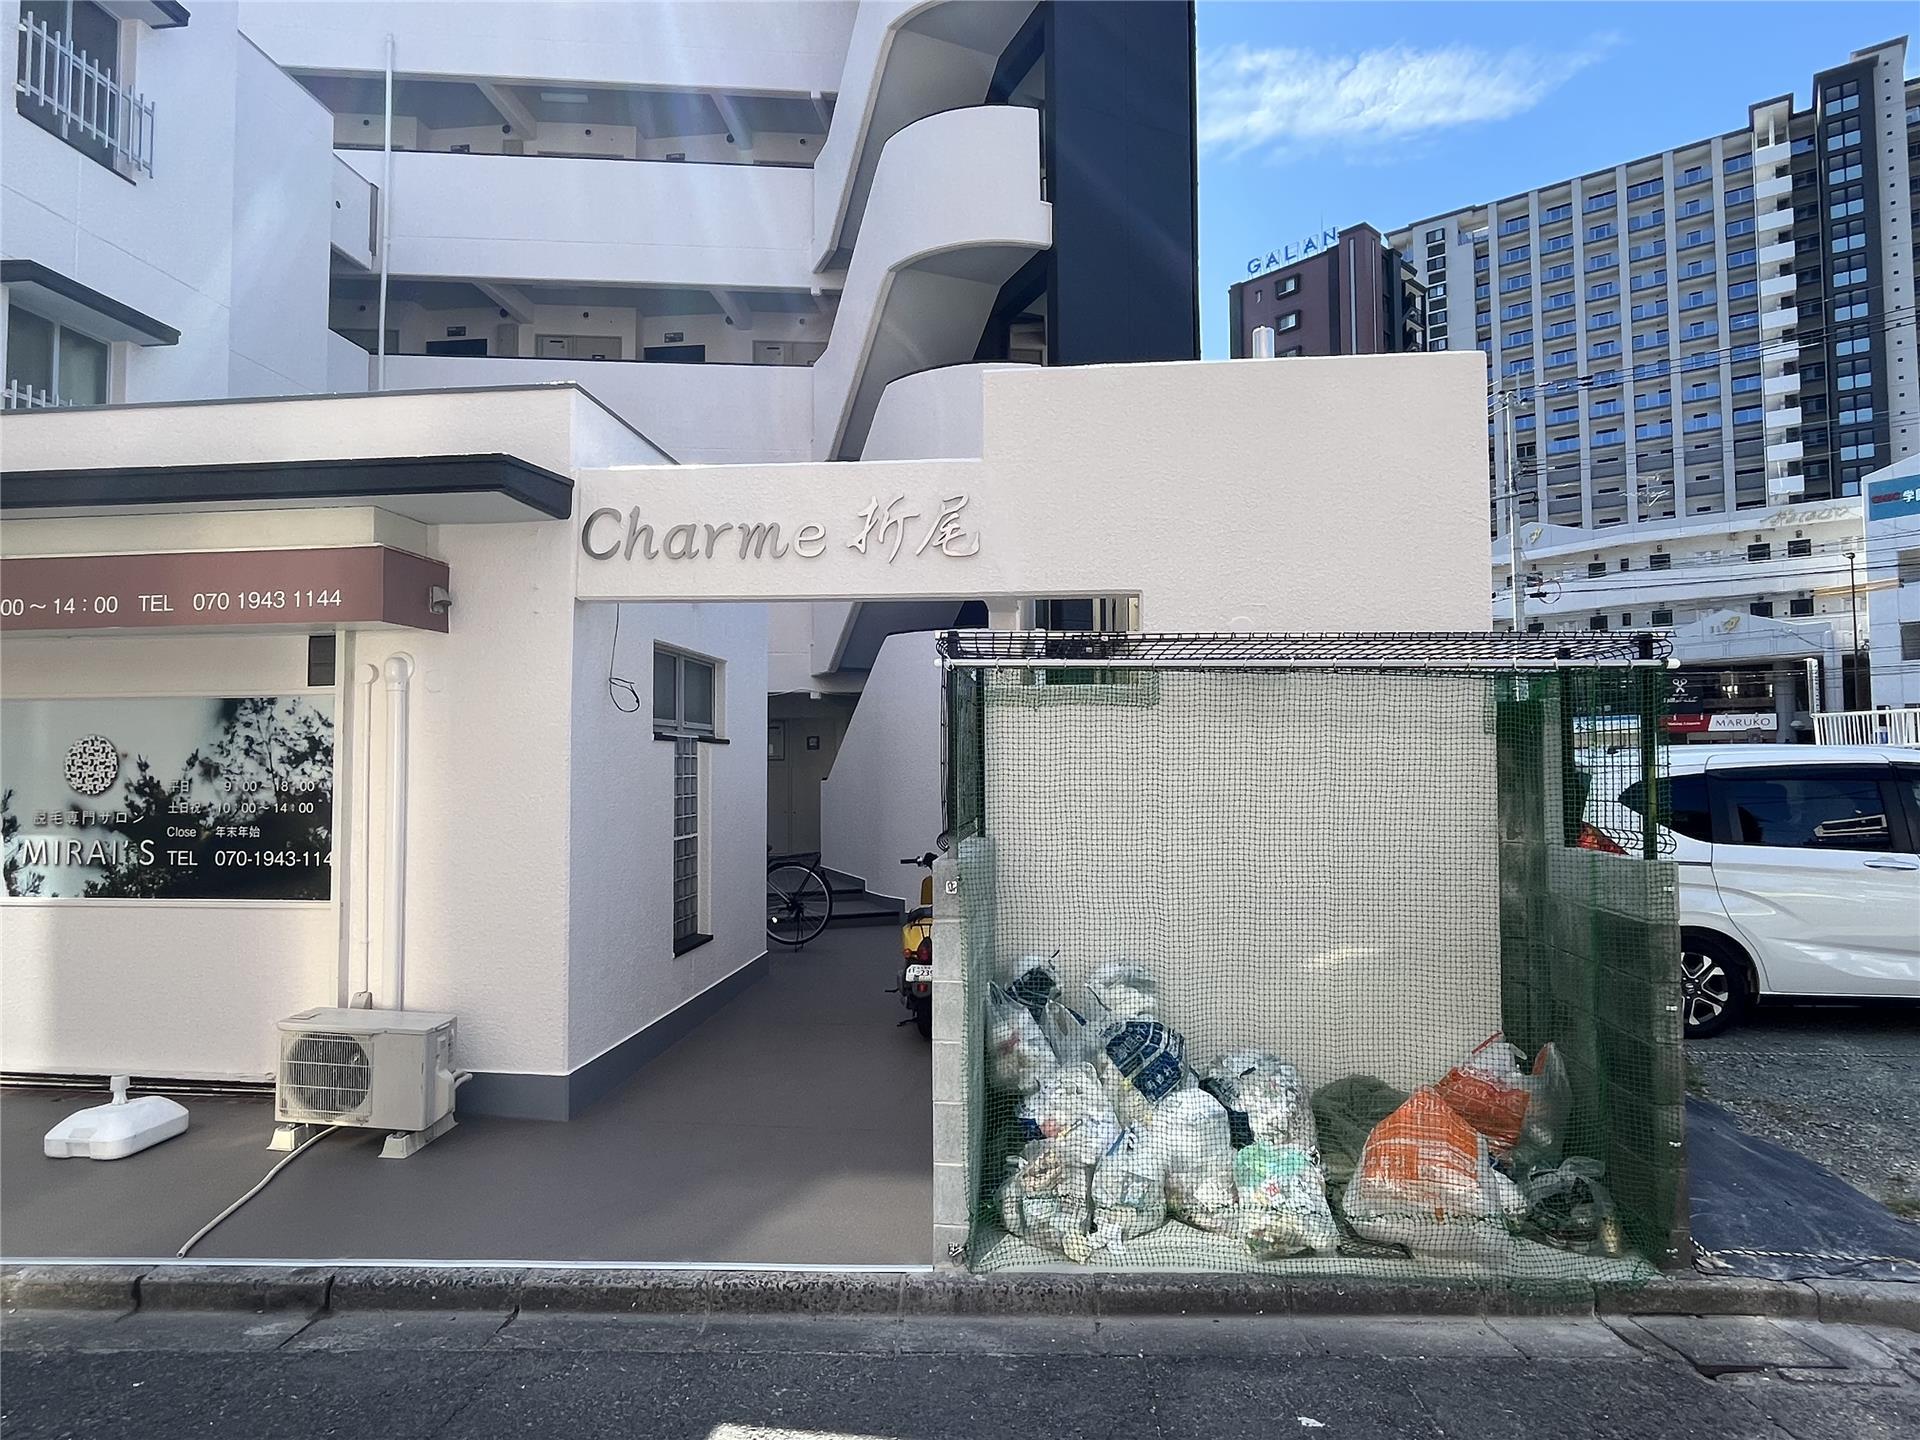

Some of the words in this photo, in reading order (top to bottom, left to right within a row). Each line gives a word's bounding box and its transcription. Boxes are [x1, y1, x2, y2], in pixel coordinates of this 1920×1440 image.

[581, 505, 827, 561] Charme
[847, 493, 981, 564] 折尾
[138, 595, 174, 612] TEL
[193, 593, 230, 611] 070
[237, 591, 286, 610] 1943
[293, 589, 342, 608] 1144
[1715, 717, 1771, 727] MARUKO
[32, 810, 145, 826] 脱毛専門サロン
[166, 826, 198, 838] Close
[215, 825, 261, 838] 年末年始
[167, 850, 198, 866] TEL
